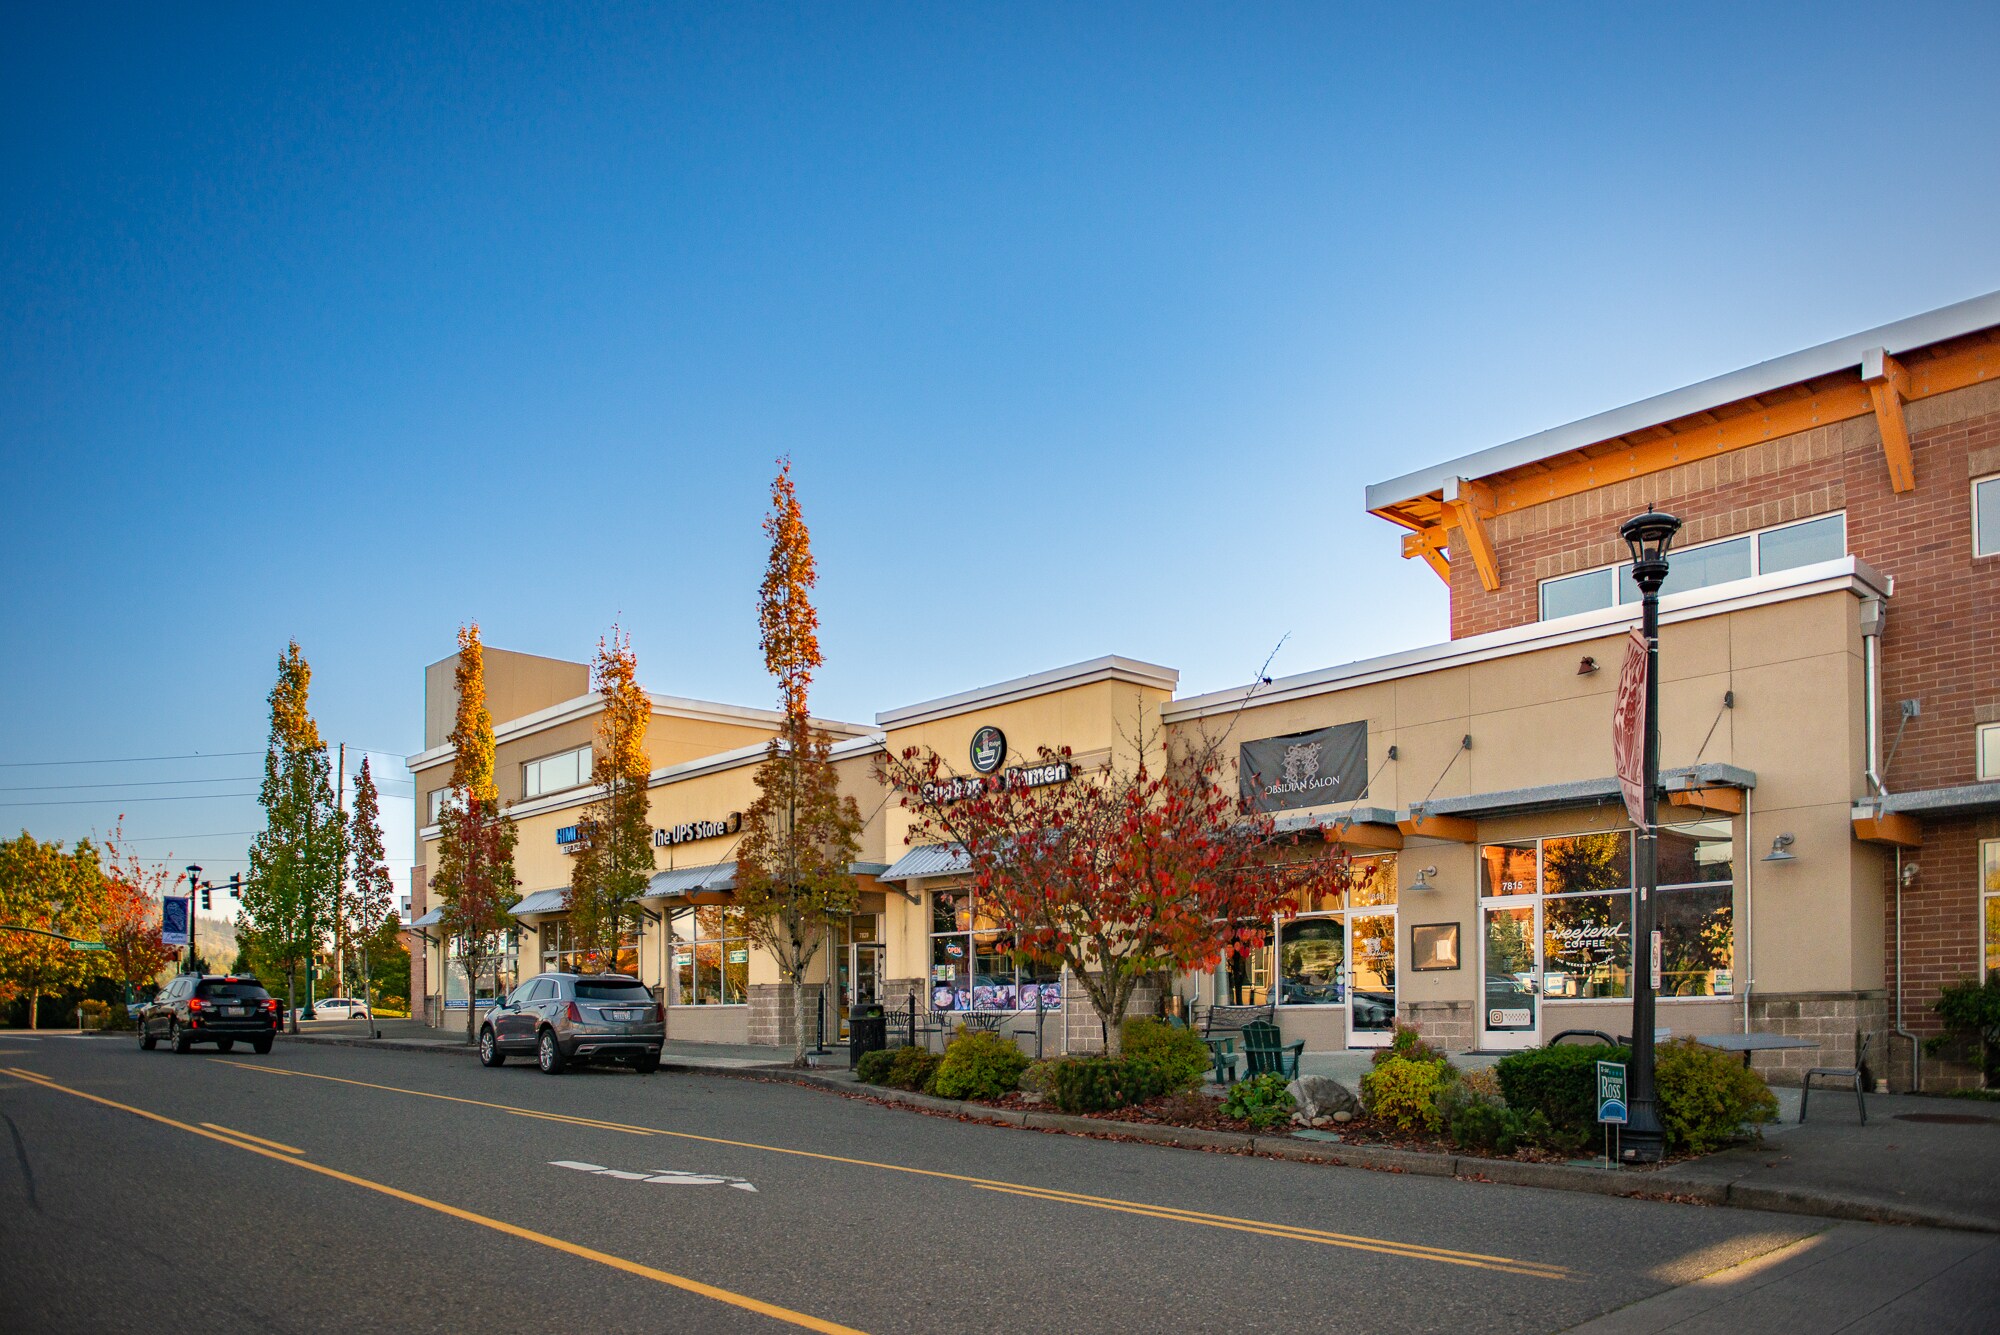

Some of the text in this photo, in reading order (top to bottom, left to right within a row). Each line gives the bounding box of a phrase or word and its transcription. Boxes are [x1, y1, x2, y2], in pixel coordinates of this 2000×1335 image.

[1264, 776, 1340, 795] OBSIDIAN SALON
[653, 820, 725, 847] The UPS Store
[1502, 881, 1523, 890] 7815
[1546, 922, 1629, 941] weekend
[948, 946, 961, 954] OPEN
[1564, 939, 1606, 948] COFFEE
